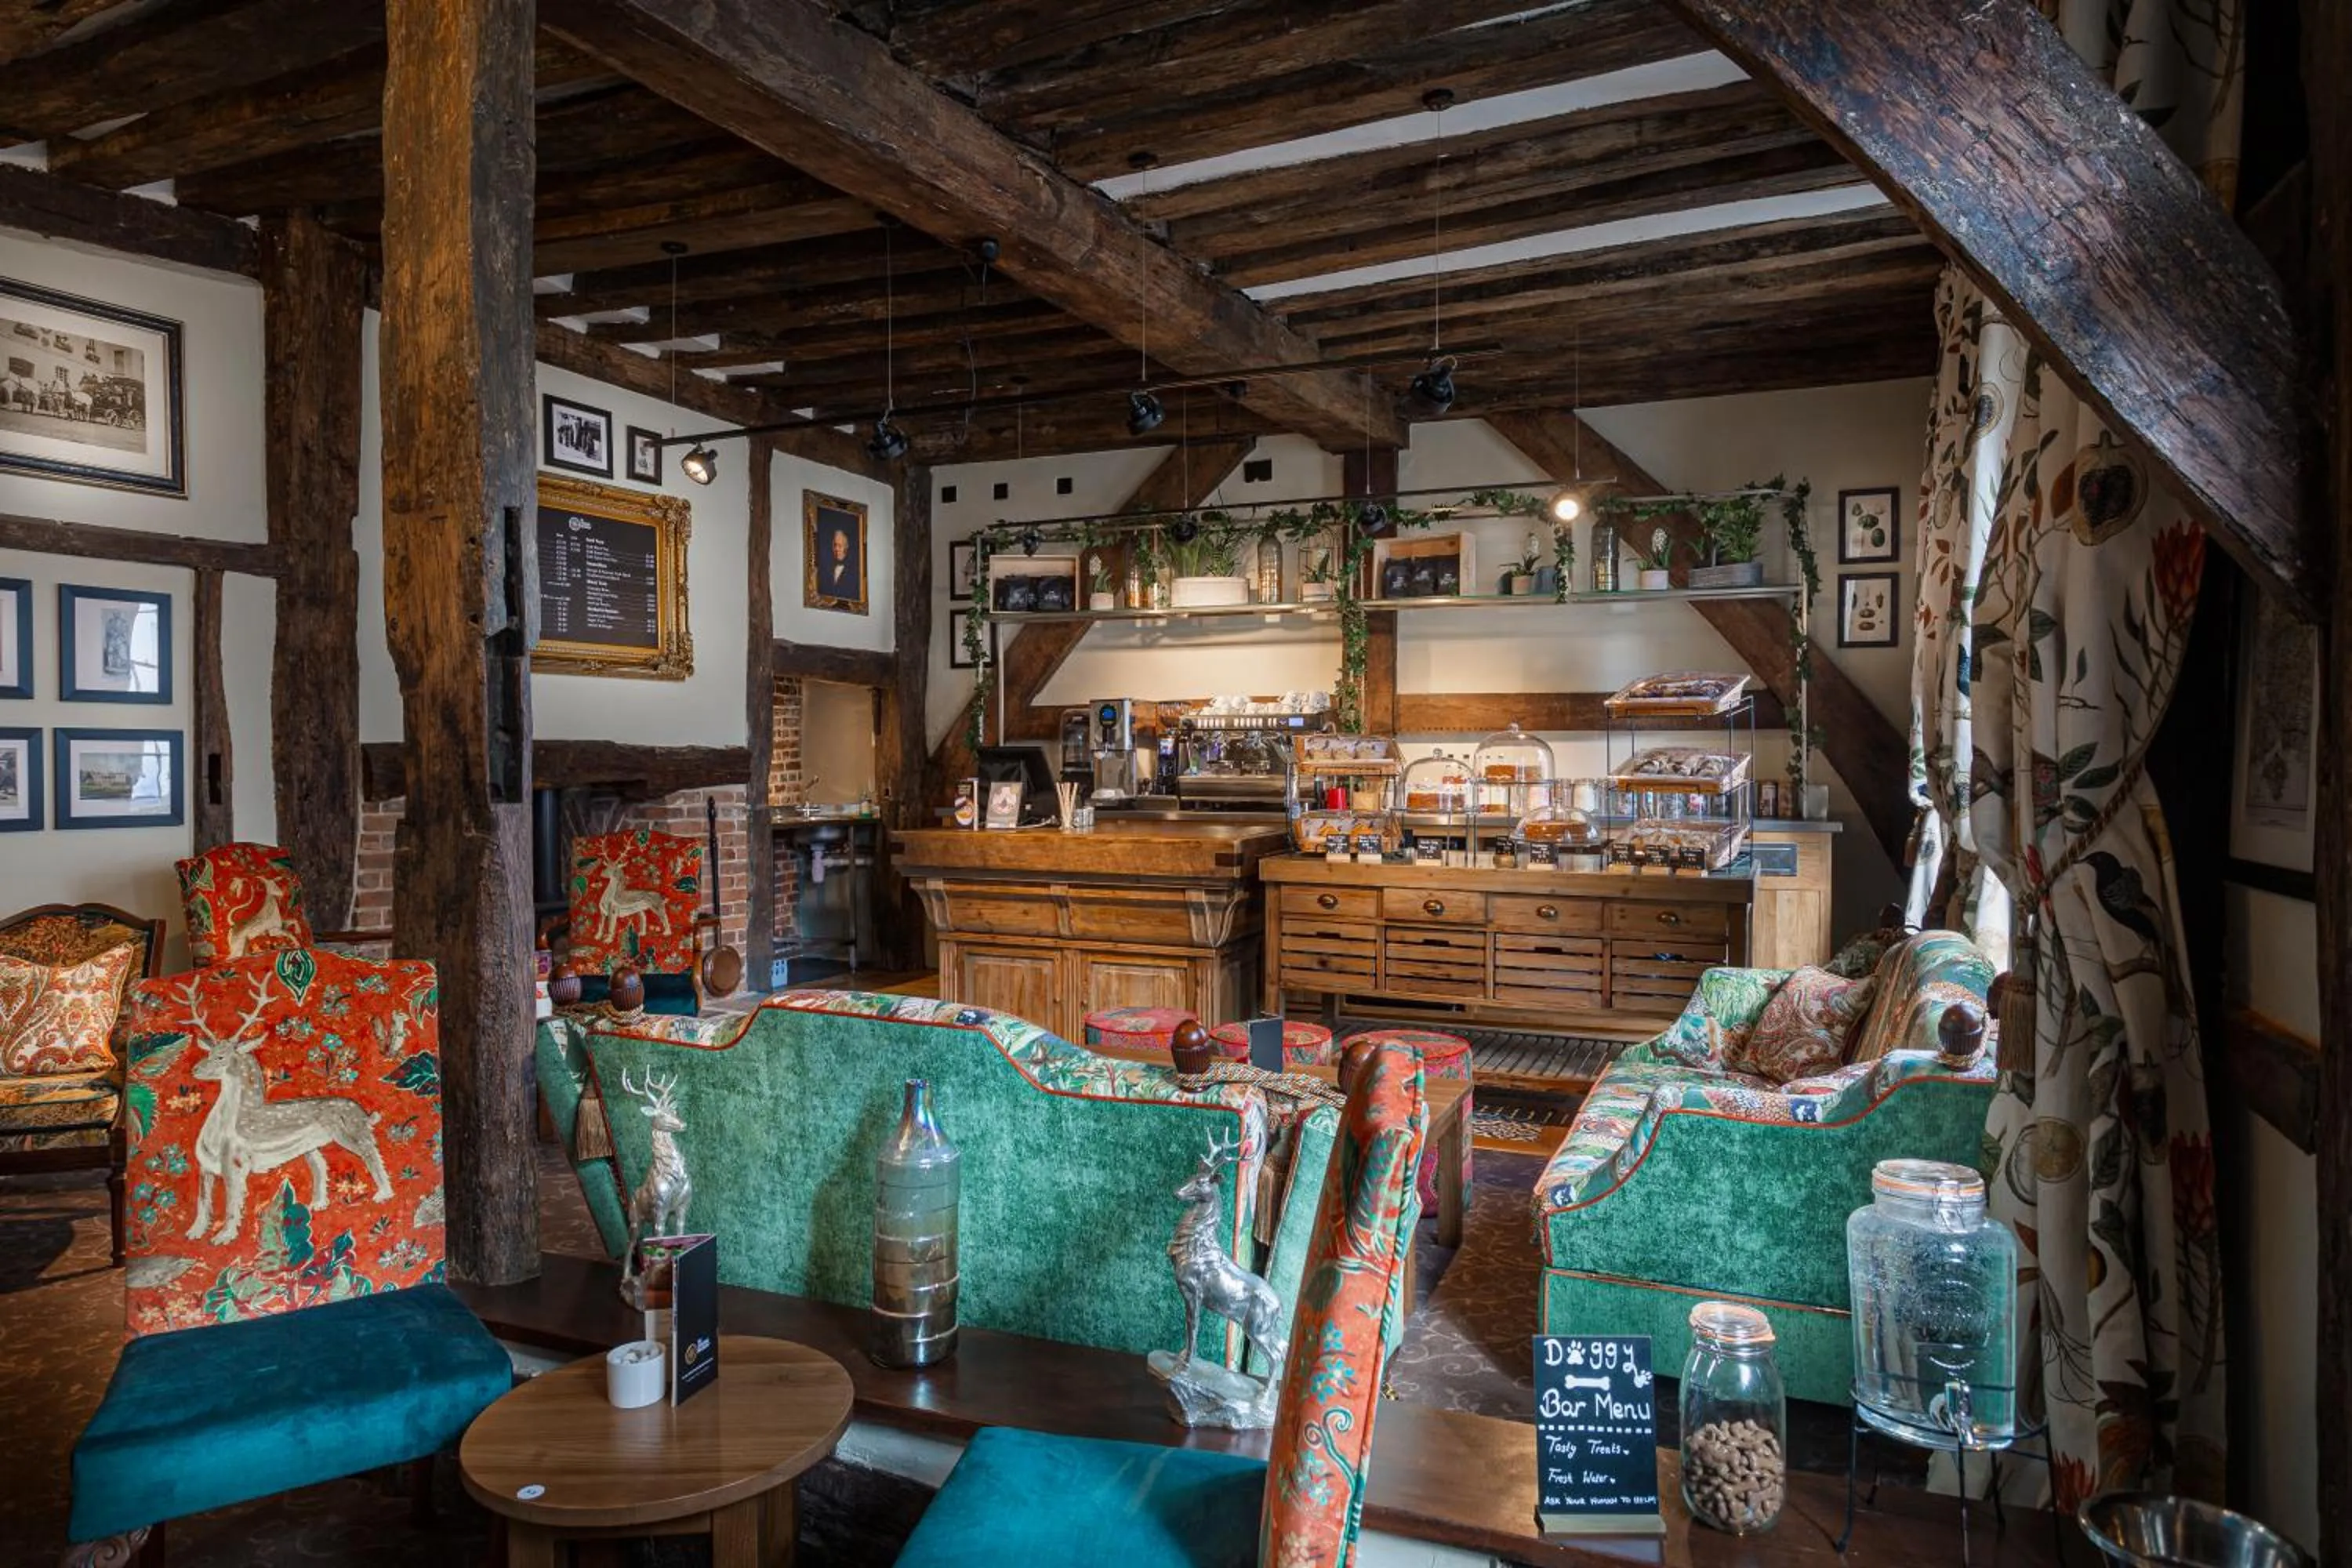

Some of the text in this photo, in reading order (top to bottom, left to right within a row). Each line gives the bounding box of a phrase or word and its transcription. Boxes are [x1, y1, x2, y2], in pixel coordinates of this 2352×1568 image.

[1539, 1388, 1651, 1420] Bar Menu
[1545, 1435, 1621, 1459] Tasty Treats
[1548, 1467, 1573, 1483] Fresh
